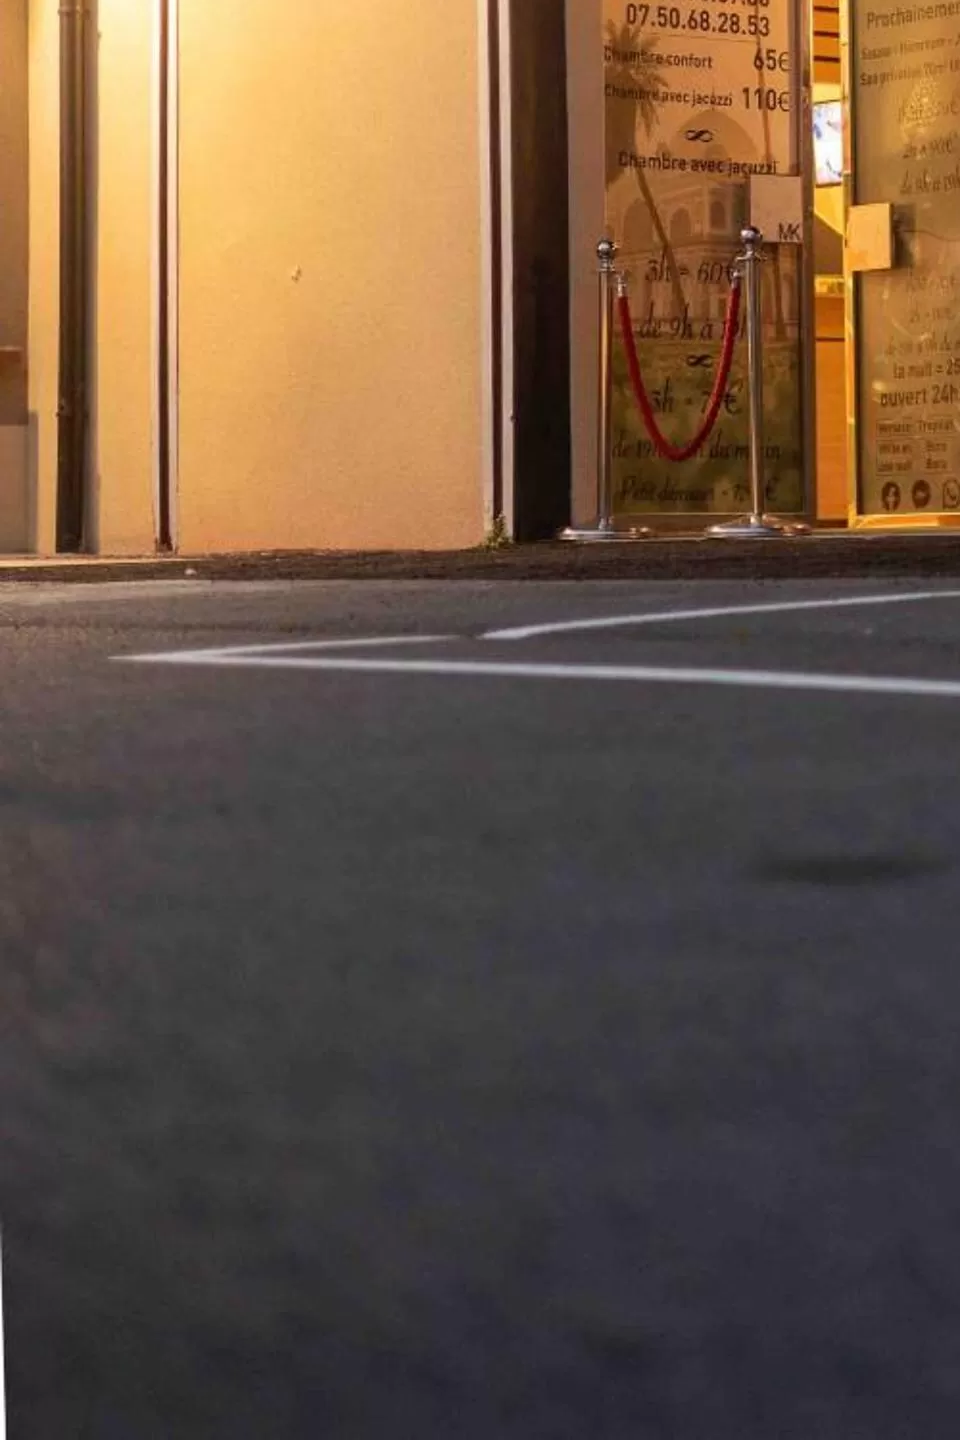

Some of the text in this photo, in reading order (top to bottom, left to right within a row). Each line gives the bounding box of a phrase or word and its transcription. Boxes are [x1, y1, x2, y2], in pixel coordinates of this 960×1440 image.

[626, 3, 770, 38] 07.50.68.28.53
[666, 53, 714, 69] confort
[753, 47, 791, 72] 65€
[662, 91, 690, 105] avec
[742, 86, 791, 112] 110€
[618, 150, 687, 171] Chambre
[690, 159, 725, 174] avec
[880, 387, 927, 408] ouvert
